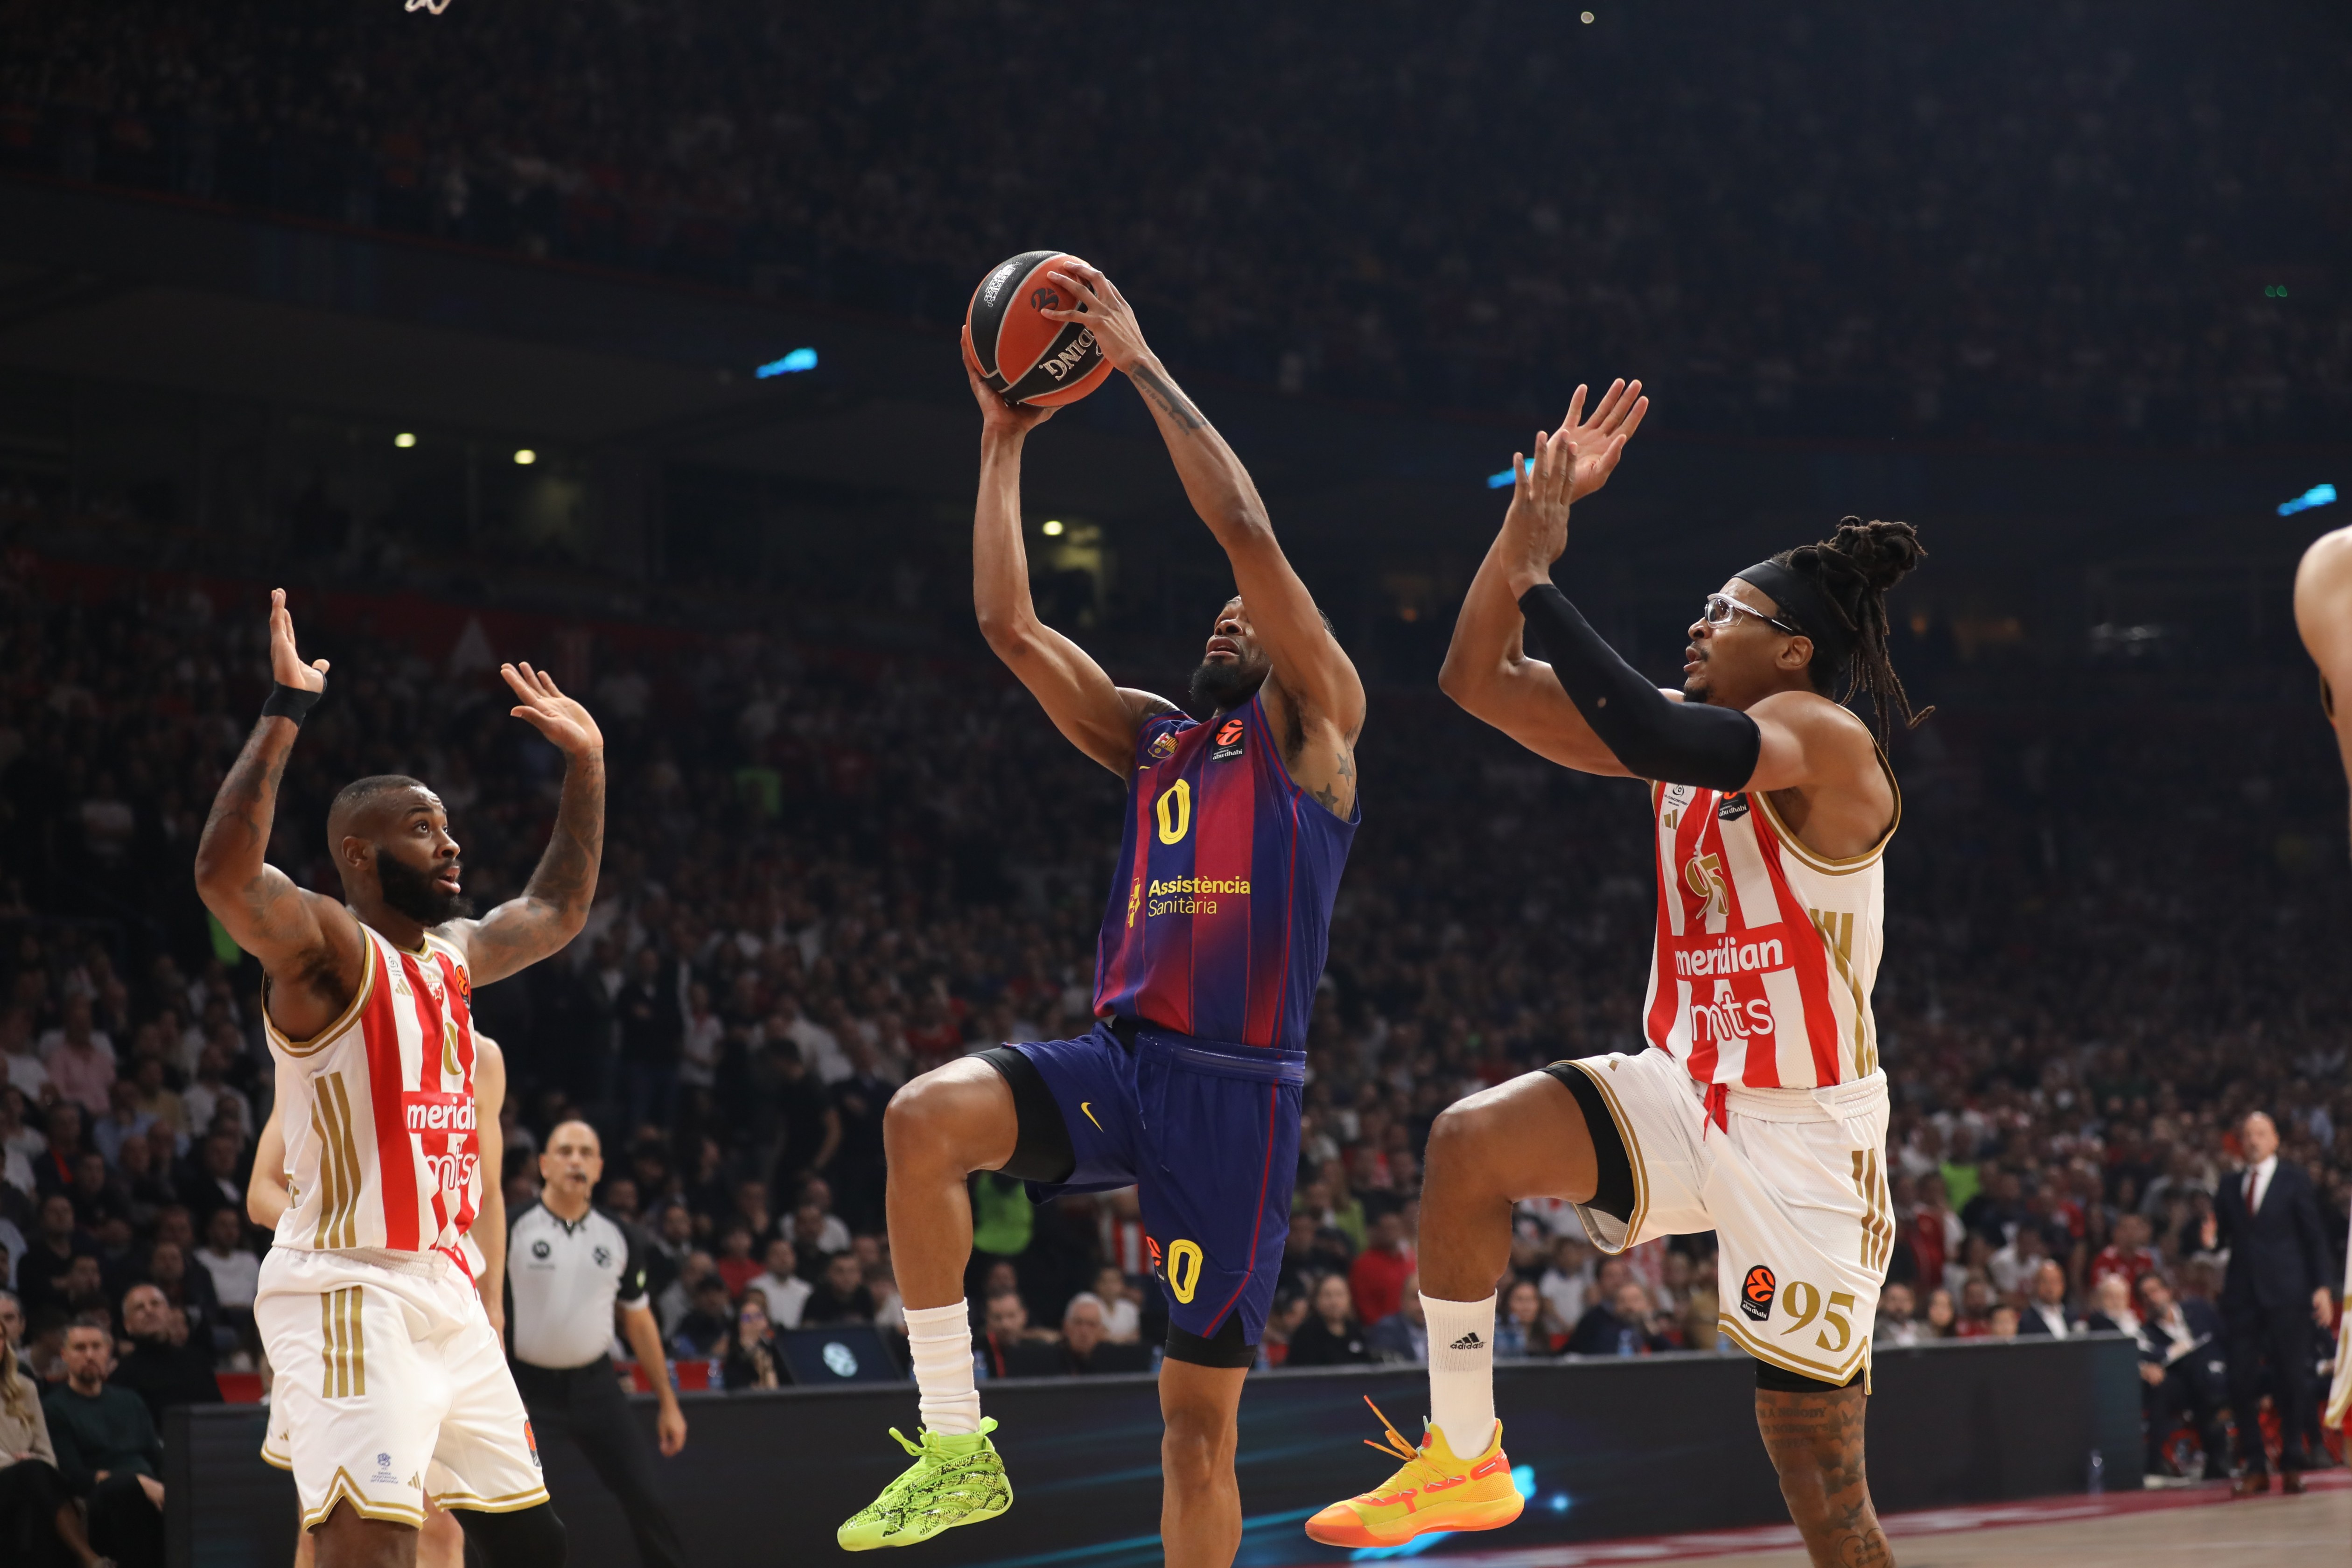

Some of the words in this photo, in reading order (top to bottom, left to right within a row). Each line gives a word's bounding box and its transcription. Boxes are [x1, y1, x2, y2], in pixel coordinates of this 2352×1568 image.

[1043, 328, 1095, 381] DING
[1224, 749, 1243, 757] dhabi
[1156, 778, 1190, 845] 0
[1729, 804, 1747, 813] dhabi
[1148, 875, 1251, 897] Assistència
[1685, 853, 1729, 920] 95
[1148, 896, 1217, 917] Sanitària
[1674, 936, 1784, 976] meridian
[1691, 993, 1774, 1042] mts
[407, 1096, 476, 1130] meridi
[425, 1144, 477, 1187] mts
[1168, 1239, 1204, 1304] 0
[1742, 1303, 1752, 1312] abu
[1751, 1308, 1768, 1319] dhabi
[1780, 1281, 1855, 1352] 95
[1450, 1341, 1485, 1350] adidas
